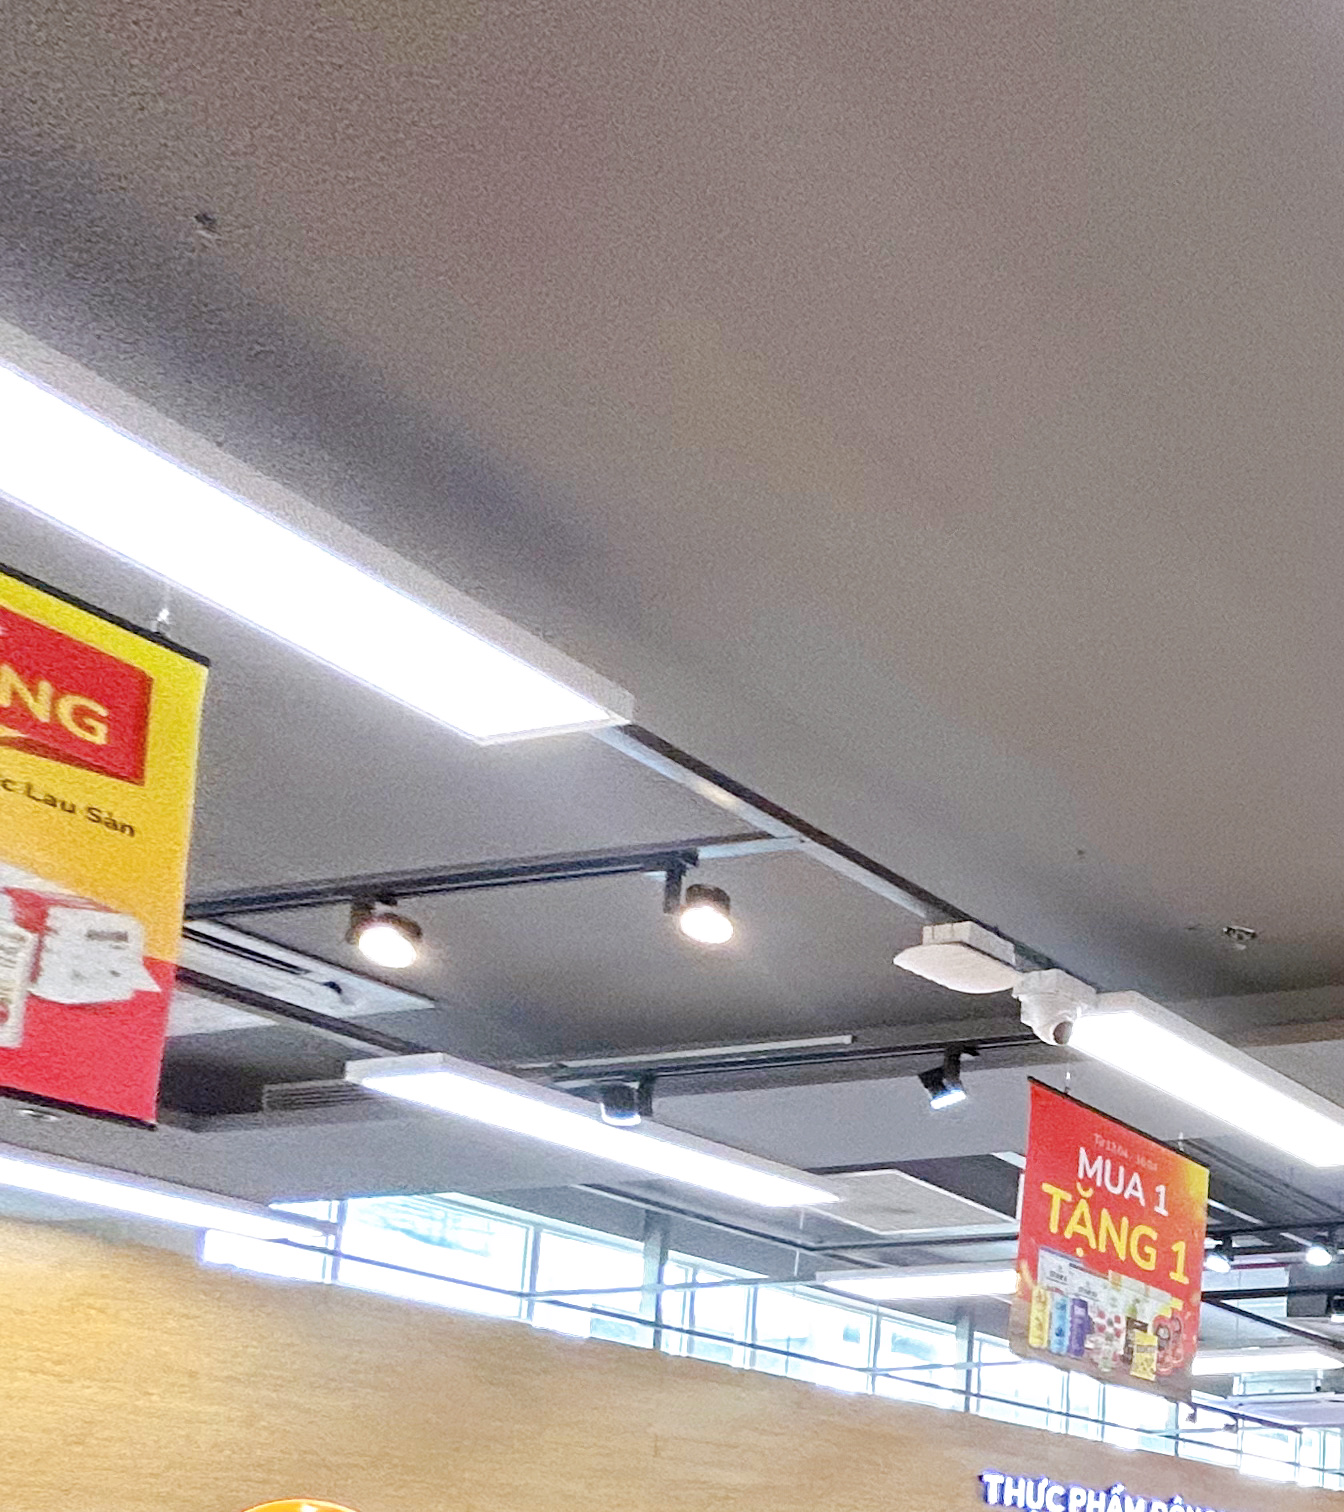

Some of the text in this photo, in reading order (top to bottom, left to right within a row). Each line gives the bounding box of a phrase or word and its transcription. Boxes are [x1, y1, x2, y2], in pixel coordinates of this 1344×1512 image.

[1077, 1146, 1169, 1217] MUA 1
[1042, 1181, 1190, 1285] TẶNG 1
